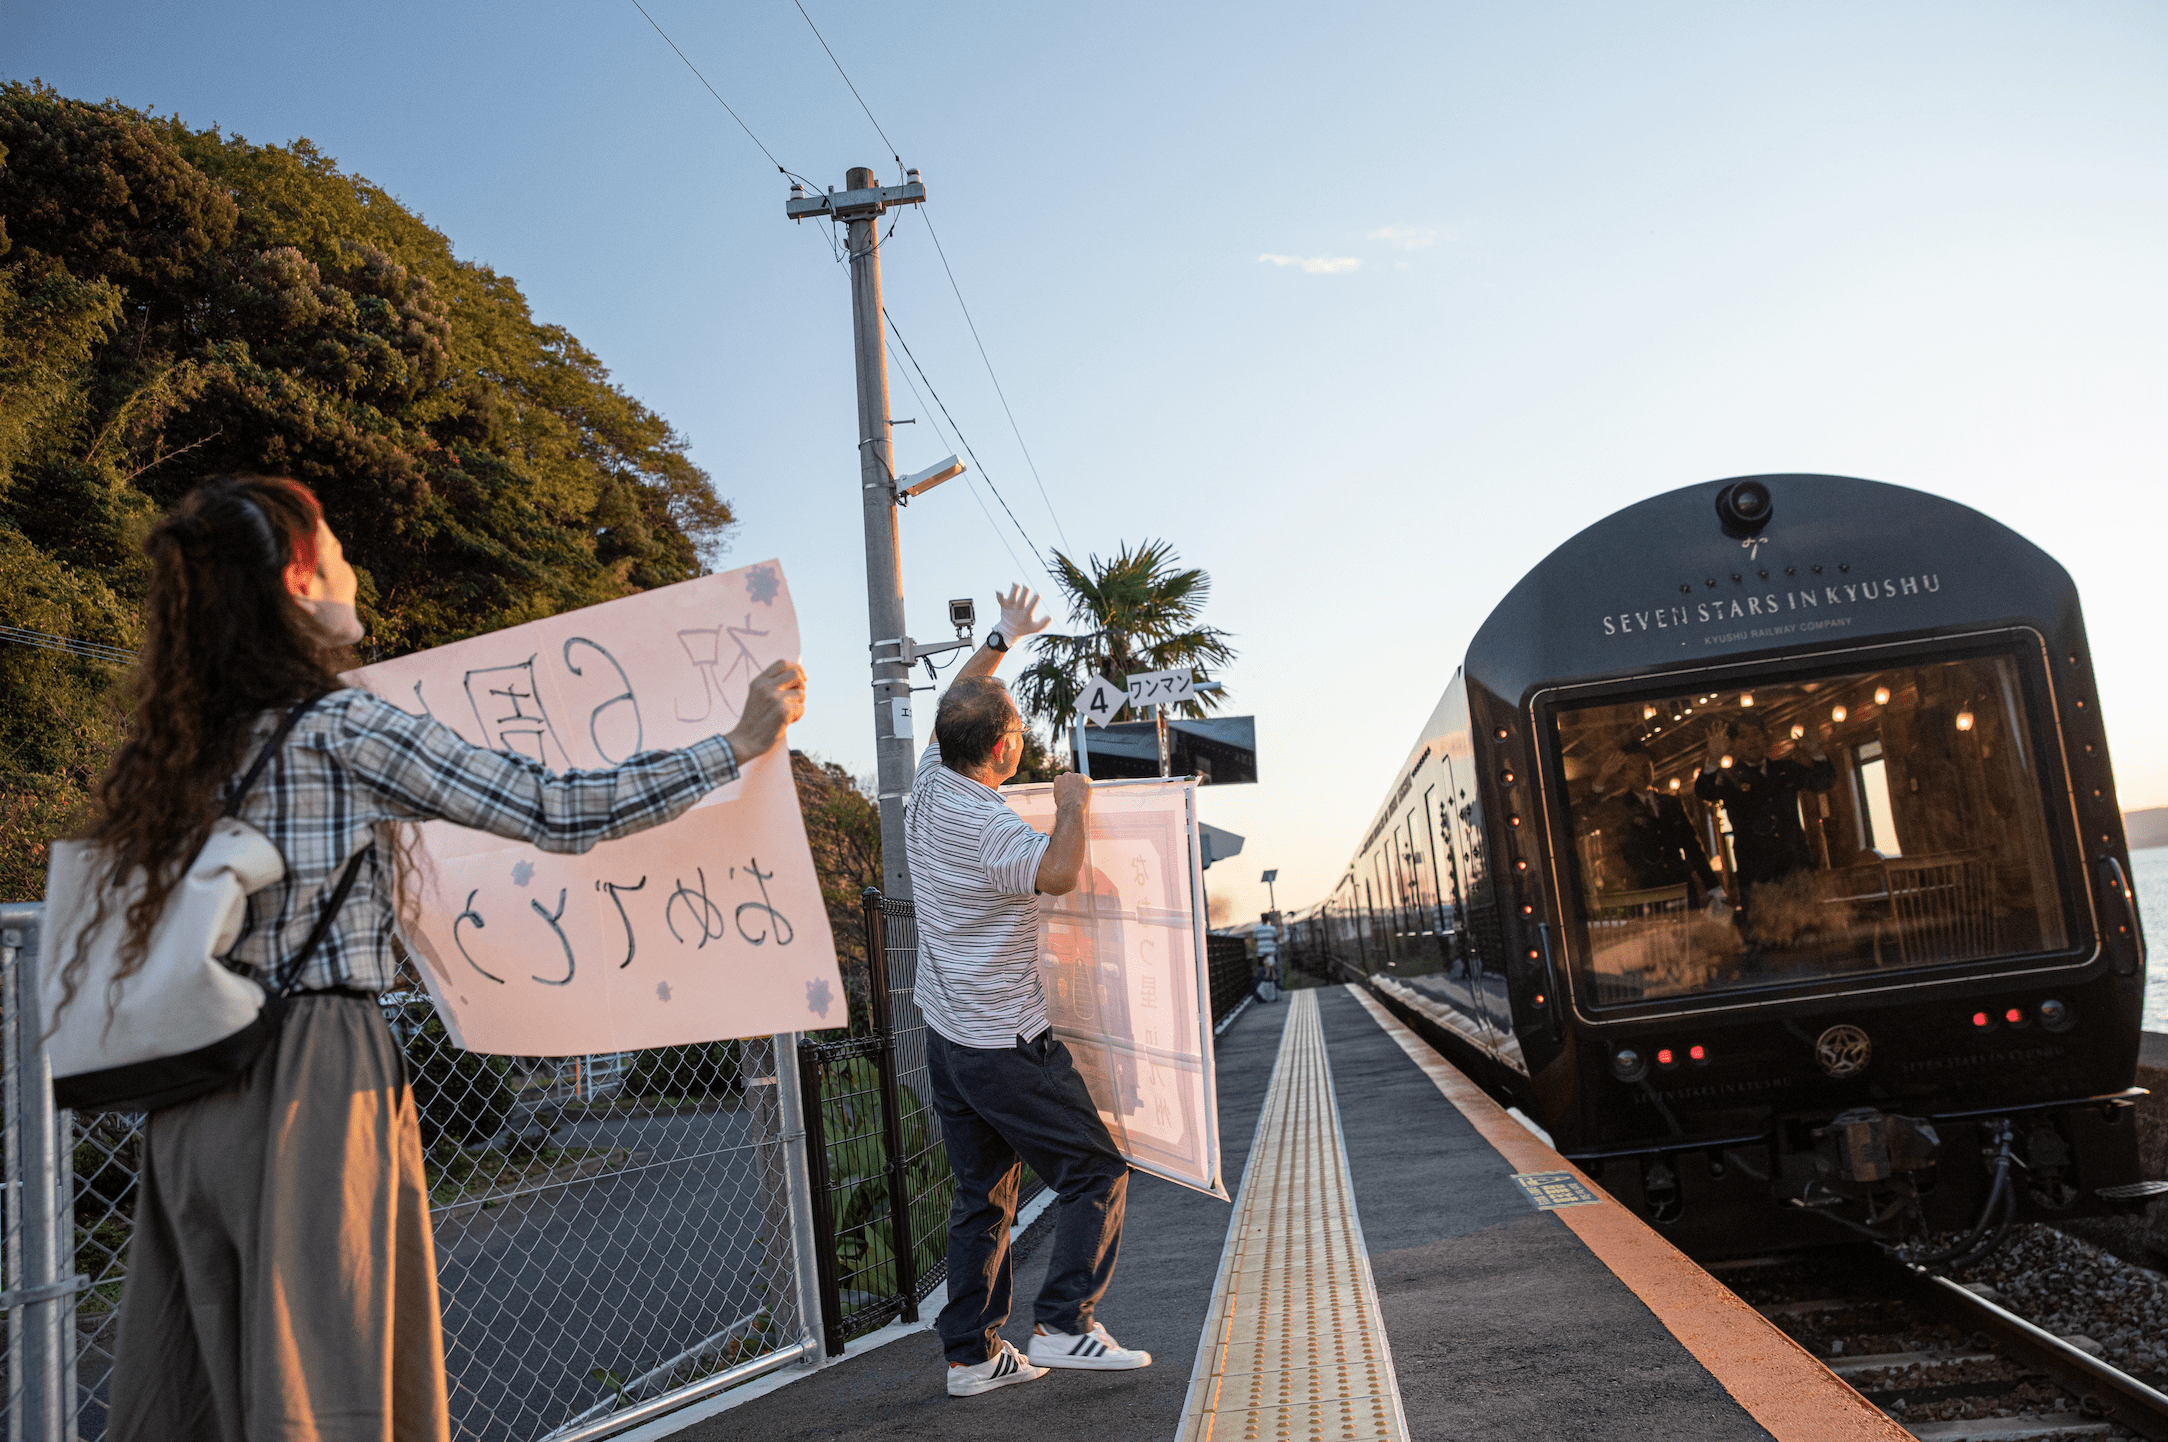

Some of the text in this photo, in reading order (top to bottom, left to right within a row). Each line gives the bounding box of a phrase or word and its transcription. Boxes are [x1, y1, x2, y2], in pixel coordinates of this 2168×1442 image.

[1603, 574, 1941, 635] SEVEN STARS IN KYUSHU
[1704, 617, 1852, 645] KYUSHU RAILWAY COMPANY
[1090, 687, 1109, 714] 4
[1129, 675, 1191, 700] ワンマン
